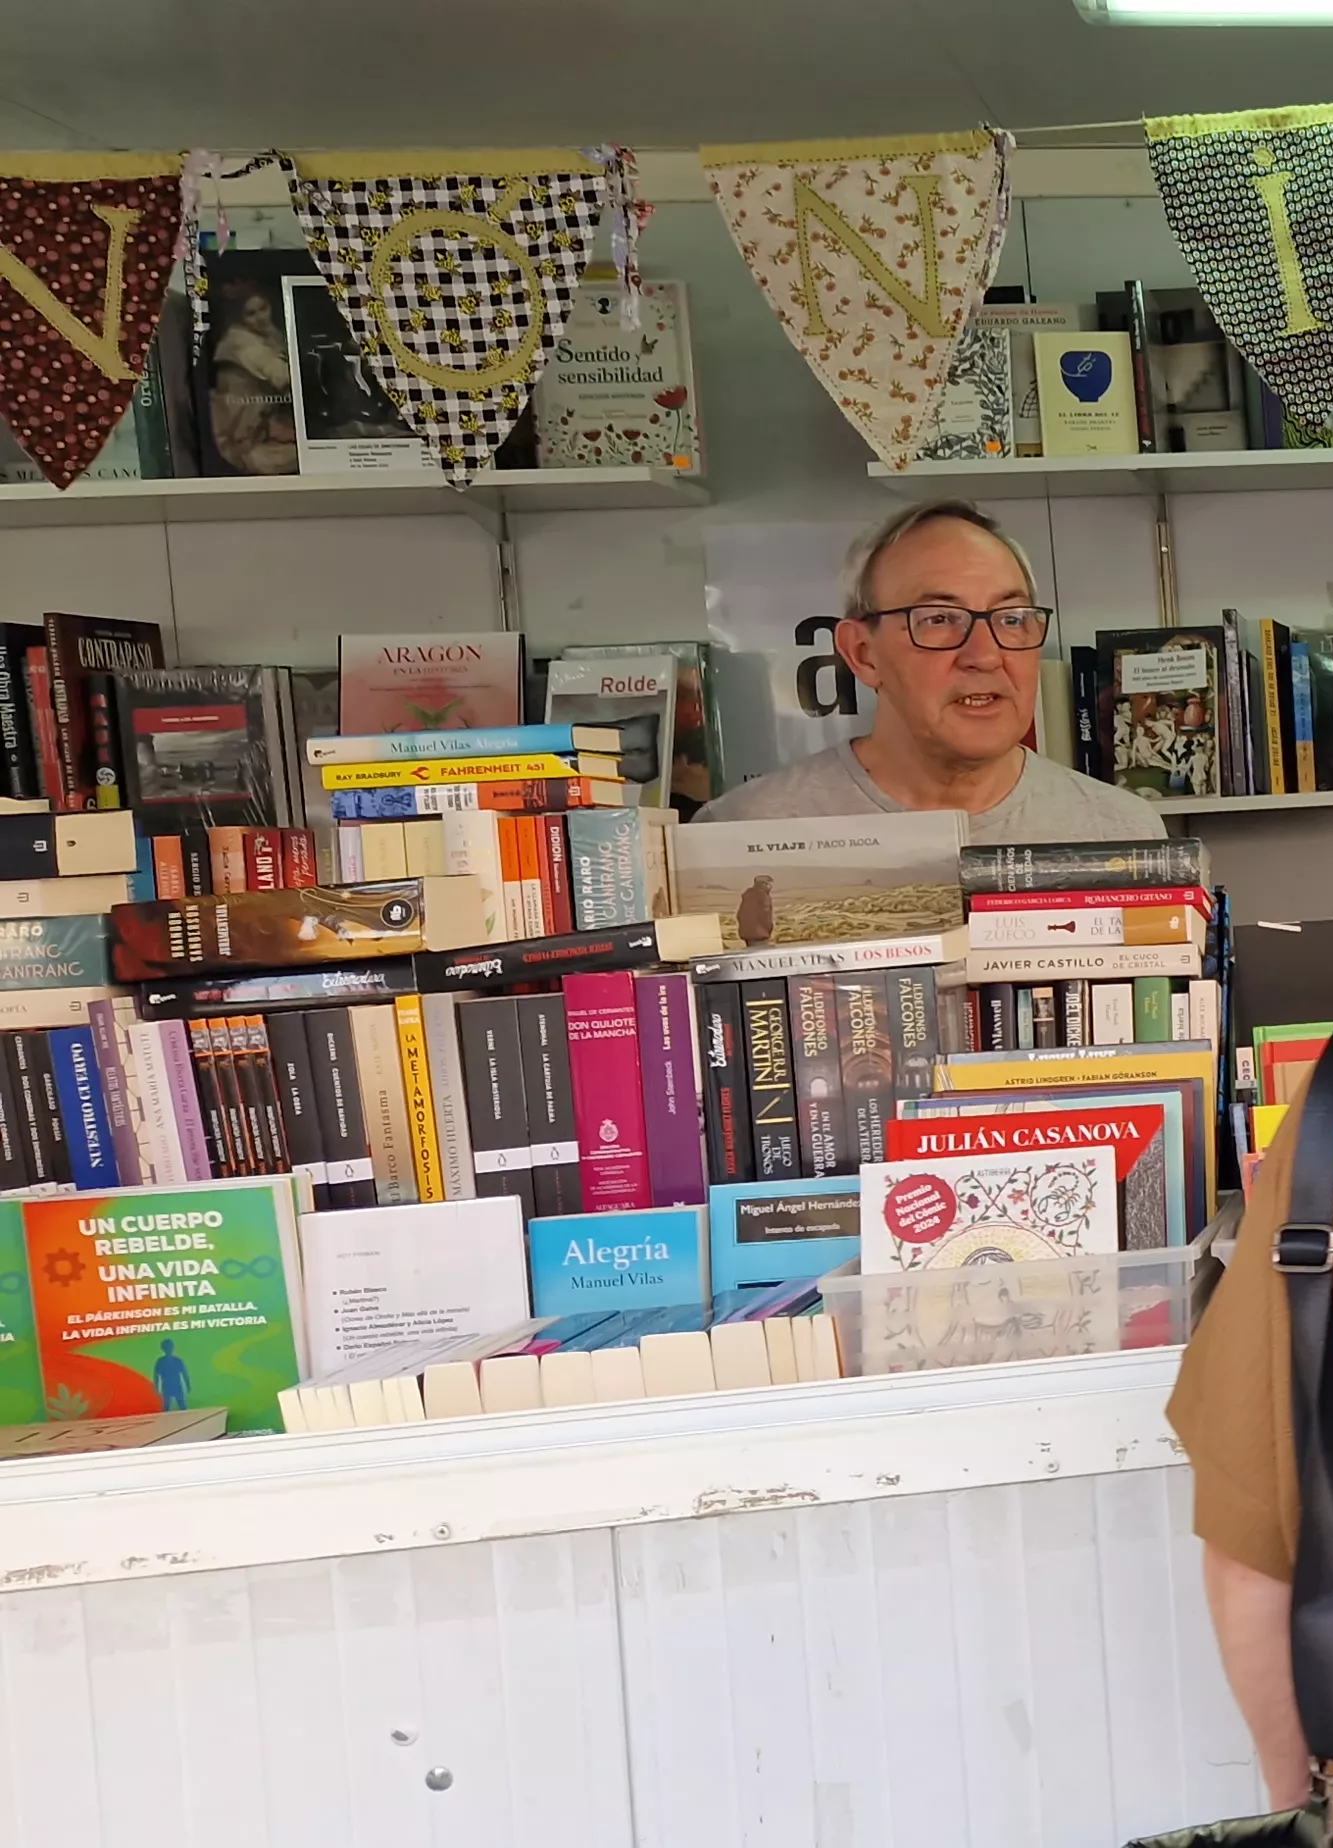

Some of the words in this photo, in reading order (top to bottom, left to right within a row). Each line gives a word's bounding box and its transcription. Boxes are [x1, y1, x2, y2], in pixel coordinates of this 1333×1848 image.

[793, 173, 958, 339] N
[974, 317, 1020, 327] EDUARDO
[1021, 316, 1067, 326] GALEANO
[556, 338, 631, 363] Sentido
[557, 366, 664, 384] sensibilidad
[78, 637, 154, 670] CONTRAPASO
[377, 641, 483, 665] ARAGÓN
[794, 615, 859, 719] a
[600, 674, 658, 694] Rolde
[1, 703, 17, 750] Maestra
[390, 741, 437, 754] Manuel
[440, 739, 471, 752] Vilas
[474, 735, 519, 751] Alegría
[355, 769, 402, 780] BRADBURY
[440, 763, 521, 777] FAHRENHEIT
[526, 762, 546, 772] 451
[550, 826, 560, 861] DIDION
[747, 844, 763, 853] EL
[767, 842, 806, 851] VIAJE
[817, 839, 845, 850] PACO
[849, 838, 880, 847] ROCA
[191, 852, 200, 883] SERGIO
[579, 856, 594, 893] RARO
[1085, 893, 1139, 905] ROMANCERO
[1140, 892, 1172, 901] GITANO
[732, 957, 798, 973] MANUEL
[801, 952, 845, 967] VILAS
[854, 947, 882, 961] LOS
[885, 944, 932, 959] BESOS
[983, 959, 1031, 972] JAVIER
[1036, 957, 1104, 970] CASTILLO
[1124, 960, 1166, 969] CRISTAL
[1136, 952, 1159, 961] CUCO
[899, 978, 916, 1048] FALCONES
[913, 983, 926, 1041] ILDEFONSO
[1065, 992, 1081, 1015] JOËL
[568, 1022, 589, 1031] DON
[591, 1017, 636, 1030] QUIJOTE
[768, 1008, 784, 1055] GEORGE
[799, 986, 818, 1057] FALCONES
[814, 992, 828, 1050] ILDEFONSO
[568, 1032, 580, 1041] DE
[580, 1031, 592, 1040] LA
[593, 1028, 636, 1039] MANCHA
[749, 1009, 771, 1083] MARTIN
[71, 1042, 92, 1101] CUERPO
[1005, 1077, 1033, 1085] ASTRID
[1035, 1075, 1074, 1084] LINDGREN
[1081, 1073, 1109, 1082] FABIAN
[378, 1089, 395, 1150] Fantasma
[407, 1047, 435, 1199] METAMORFOSIS
[441, 1094, 456, 1142] HUERTA
[77, 1102, 103, 1168] NUESTRO
[917, 1126, 1006, 1154] JULIÁN
[1012, 1121, 1141, 1147] CASANOVA
[760, 1135, 773, 1175] TRONOS
[779, 1136, 792, 1168] JUEGO
[812, 1133, 825, 1178] GUERRA
[824, 1134, 836, 1168] AMOR
[386, 1154, 400, 1191] Barco
[445, 1145, 463, 1197] MÁXIMO
[895, 1183, 932, 1204] Premio
[896, 1191, 941, 1215] Nacional
[740, 1202, 773, 1217] Miguel
[777, 1198, 806, 1216] Ángel
[899, 1214, 918, 1228] del
[917, 1202, 947, 1222] Cómic
[79, 1217, 116, 1236] UN
[121, 1210, 223, 1233] CUERPO
[913, 1215, 940, 1235] 2024
[95, 1233, 215, 1256] REBELDE,
[562, 1237, 670, 1270] Alegría
[99, 1264, 154, 1282] UNA
[157, 1259, 220, 1279] VIDA
[571, 1274, 624, 1290] Manuel
[628, 1272, 664, 1286] Vilas
[107, 1280, 216, 1303] INFINITA
[67, 1314, 84, 1324] EL
[85, 1306, 161, 1323] PÁRKINSON
[163, 1307, 180, 1316] ES
[182, 1305, 197, 1315] MI
[62, 1331, 80, 1341] LA
[82, 1327, 114, 1339] VIDA
[116, 1322, 171, 1336] INFINITA
[173, 1321, 189, 1331] ES
[190, 1320, 205, 1330] MI
[207, 1315, 267, 1328] VICTORIA
